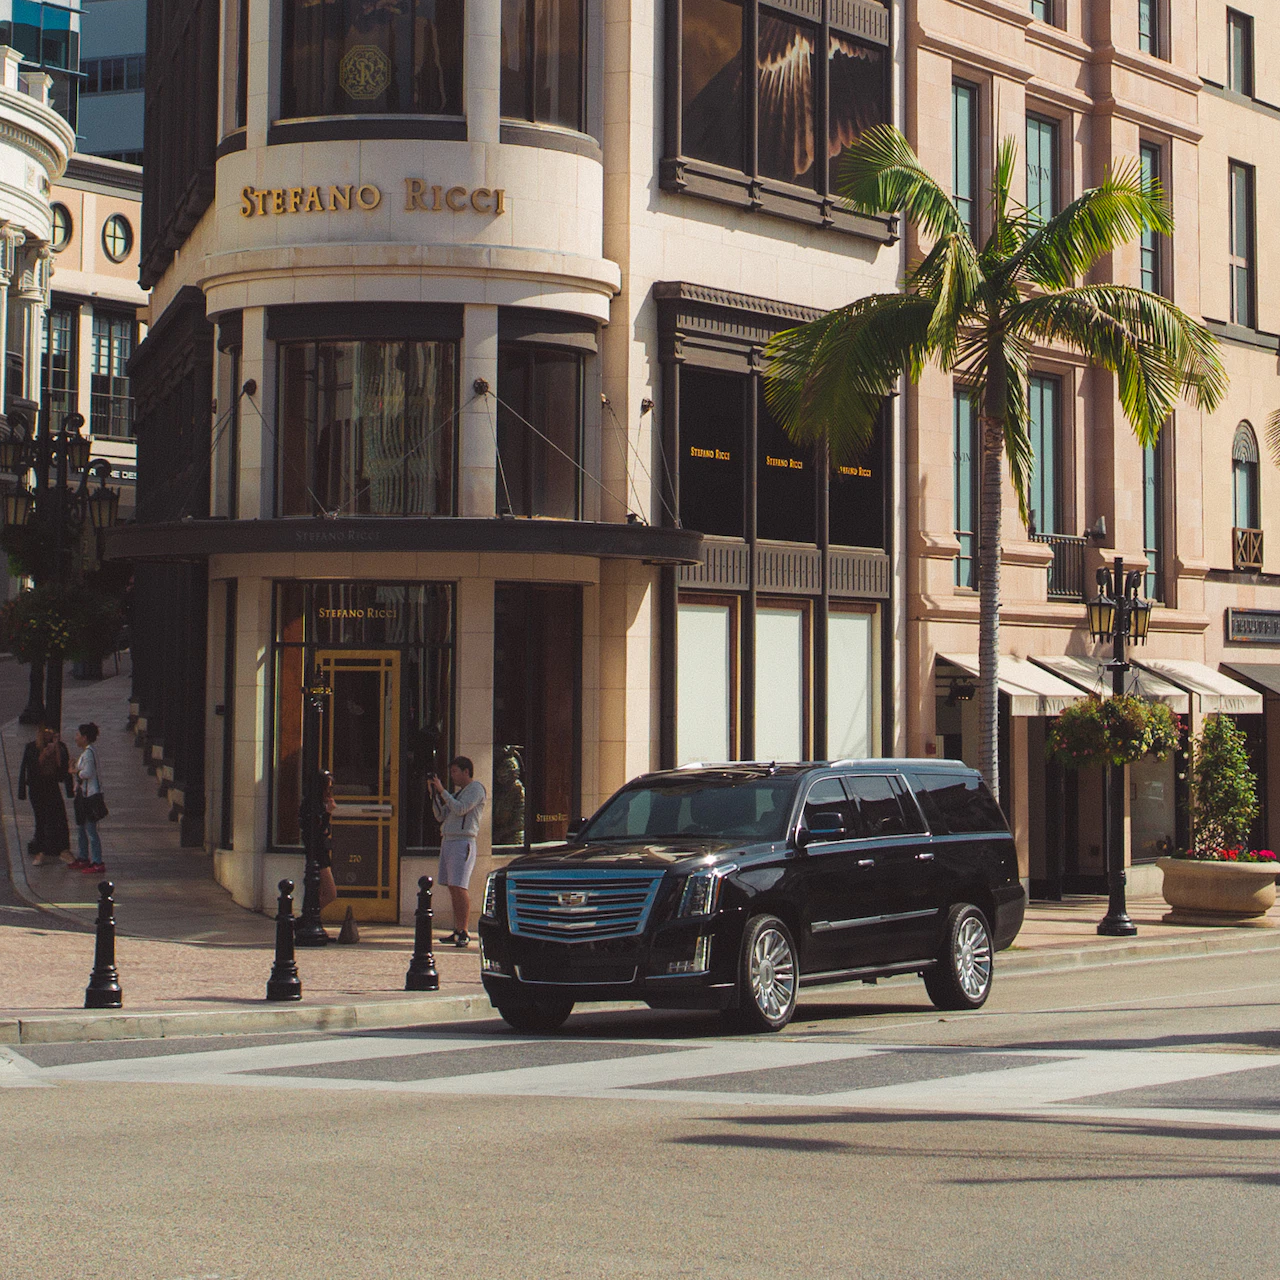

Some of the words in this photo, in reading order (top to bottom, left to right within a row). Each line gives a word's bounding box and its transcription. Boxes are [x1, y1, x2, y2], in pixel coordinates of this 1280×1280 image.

[239, 184, 382, 218] STEFANO
[404, 177, 506, 214] RICCI
[690, 446, 715, 459] STEFANO
[715, 448, 730, 461] RICCI
[766, 455, 788, 468] STEFANO
[789, 458, 803, 470] RICCI
[858, 466, 872, 478] RICCI
[295, 531, 345, 541] STEFANO
[319, 608, 365, 618] STEFANO
[367, 607, 397, 618] RICCI
